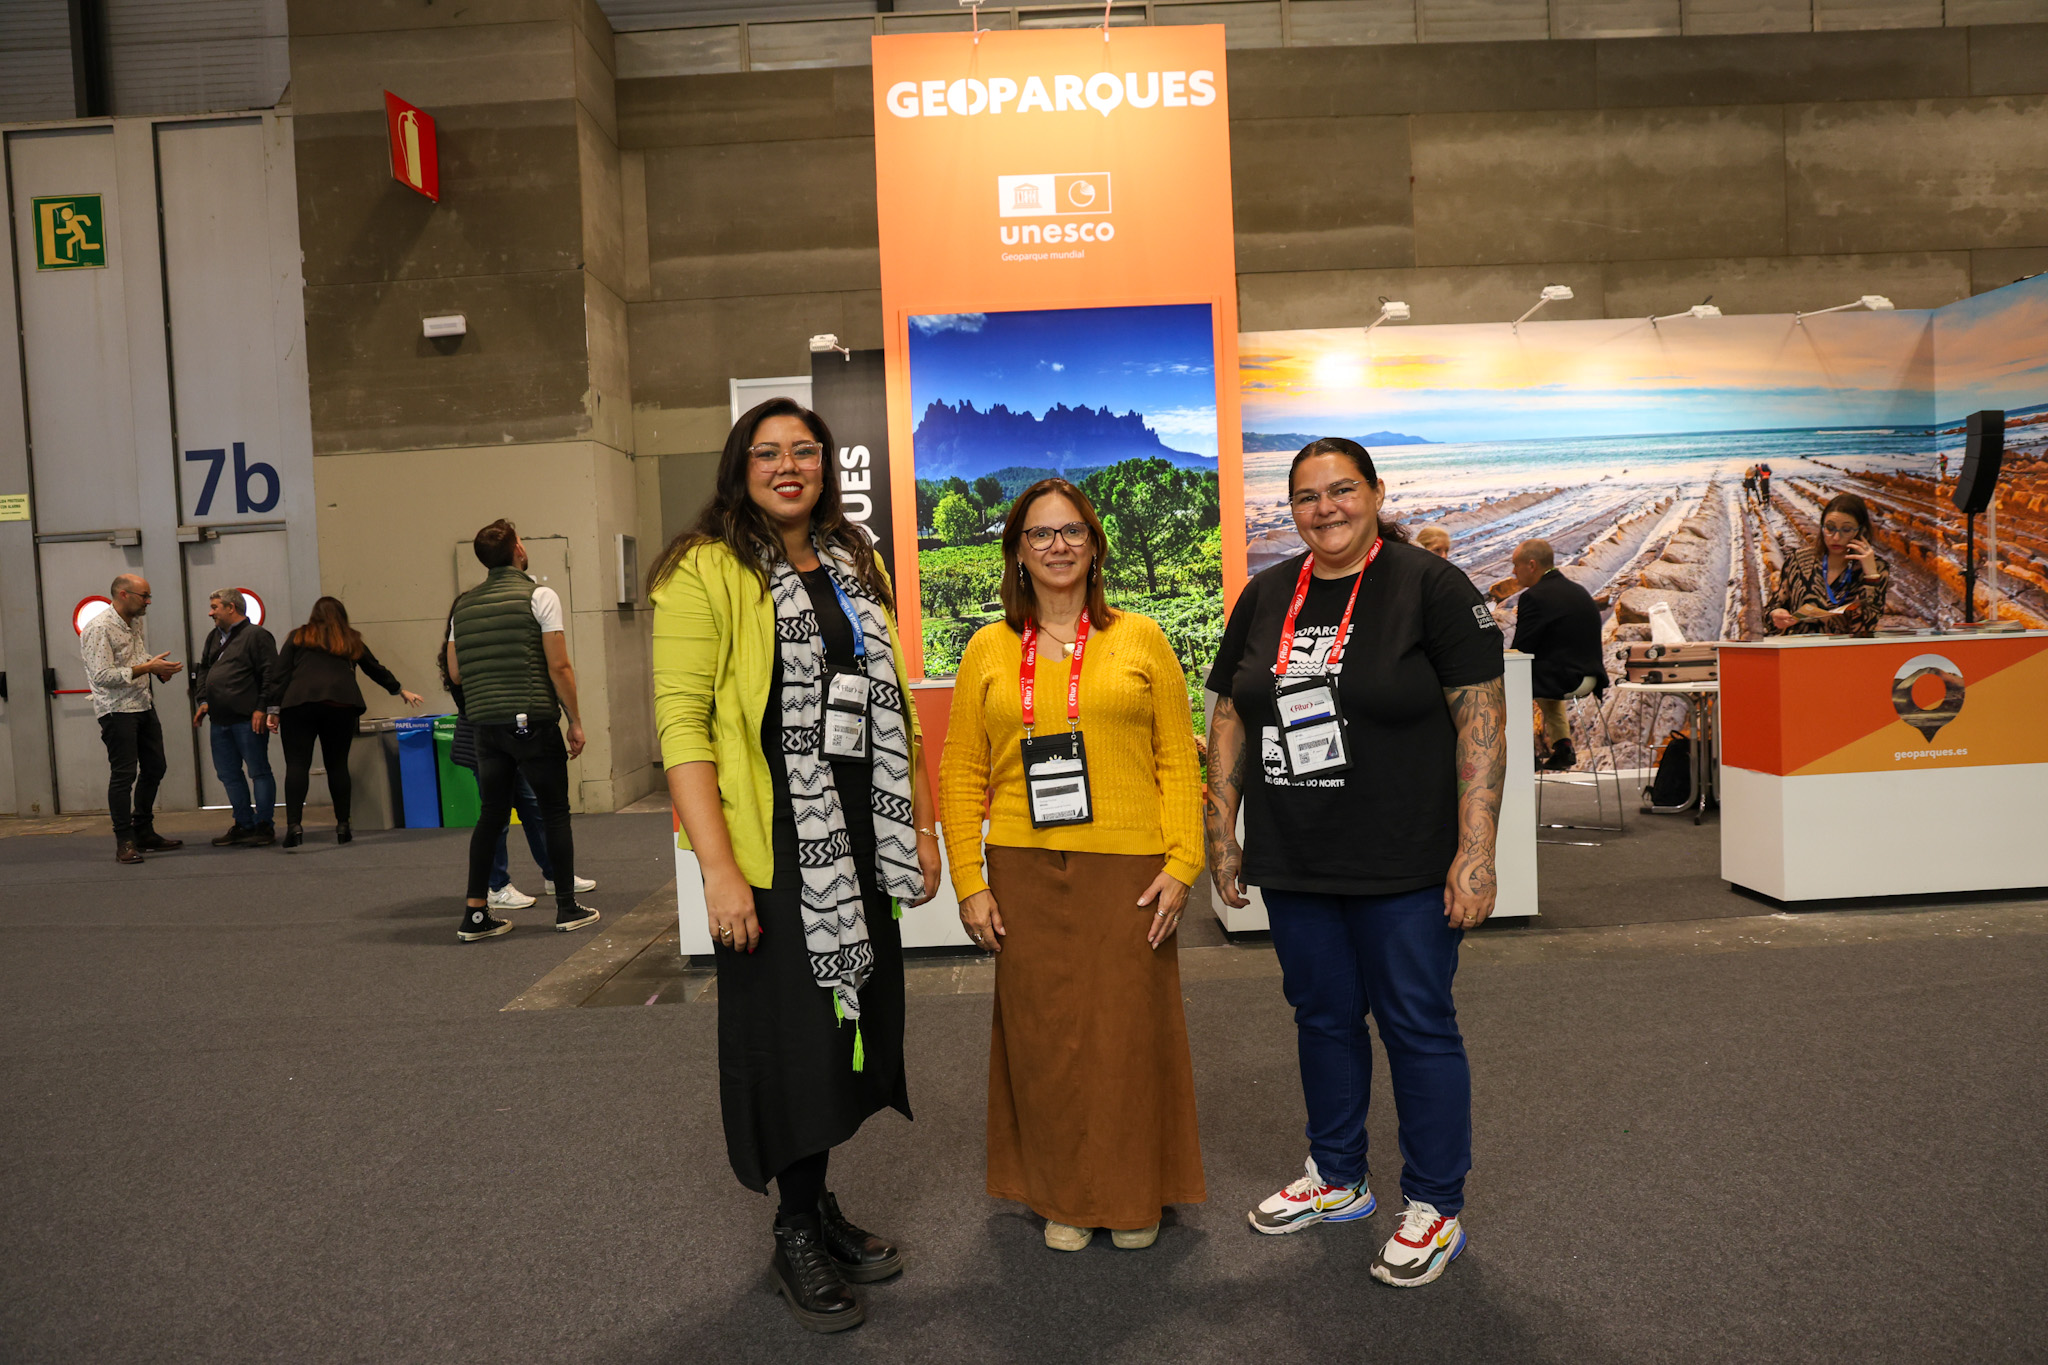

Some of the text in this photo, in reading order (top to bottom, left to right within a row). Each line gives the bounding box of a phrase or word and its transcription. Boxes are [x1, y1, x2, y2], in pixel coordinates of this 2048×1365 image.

[886, 70, 1216, 118] GEOPARQUES
[1000, 222, 1115, 245] unesco
[1001, 249, 1085, 262] Geoparque mundial
[185, 442, 281, 516] 7b
[839, 445, 880, 546] UES
[1894, 748, 1968, 761] geoparques.es
[1319, 779, 1345, 788] NORTE
